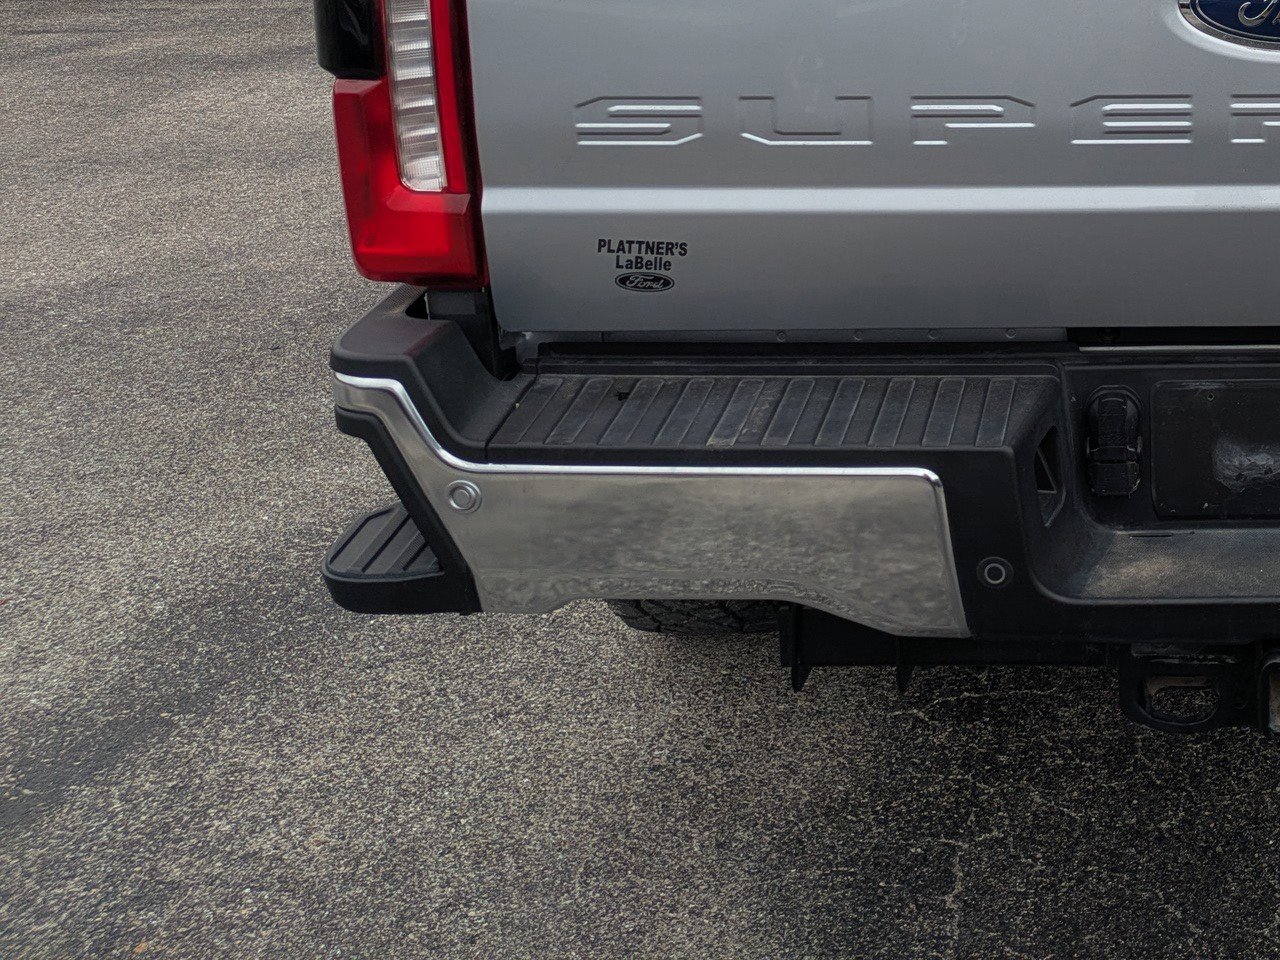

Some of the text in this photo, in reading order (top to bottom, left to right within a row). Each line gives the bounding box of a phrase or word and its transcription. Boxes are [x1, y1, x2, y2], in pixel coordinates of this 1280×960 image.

[597, 238, 689, 257] PLATTNER'S
[615, 255, 672, 271] LaBelle
[626, 275, 664, 289] Ford
